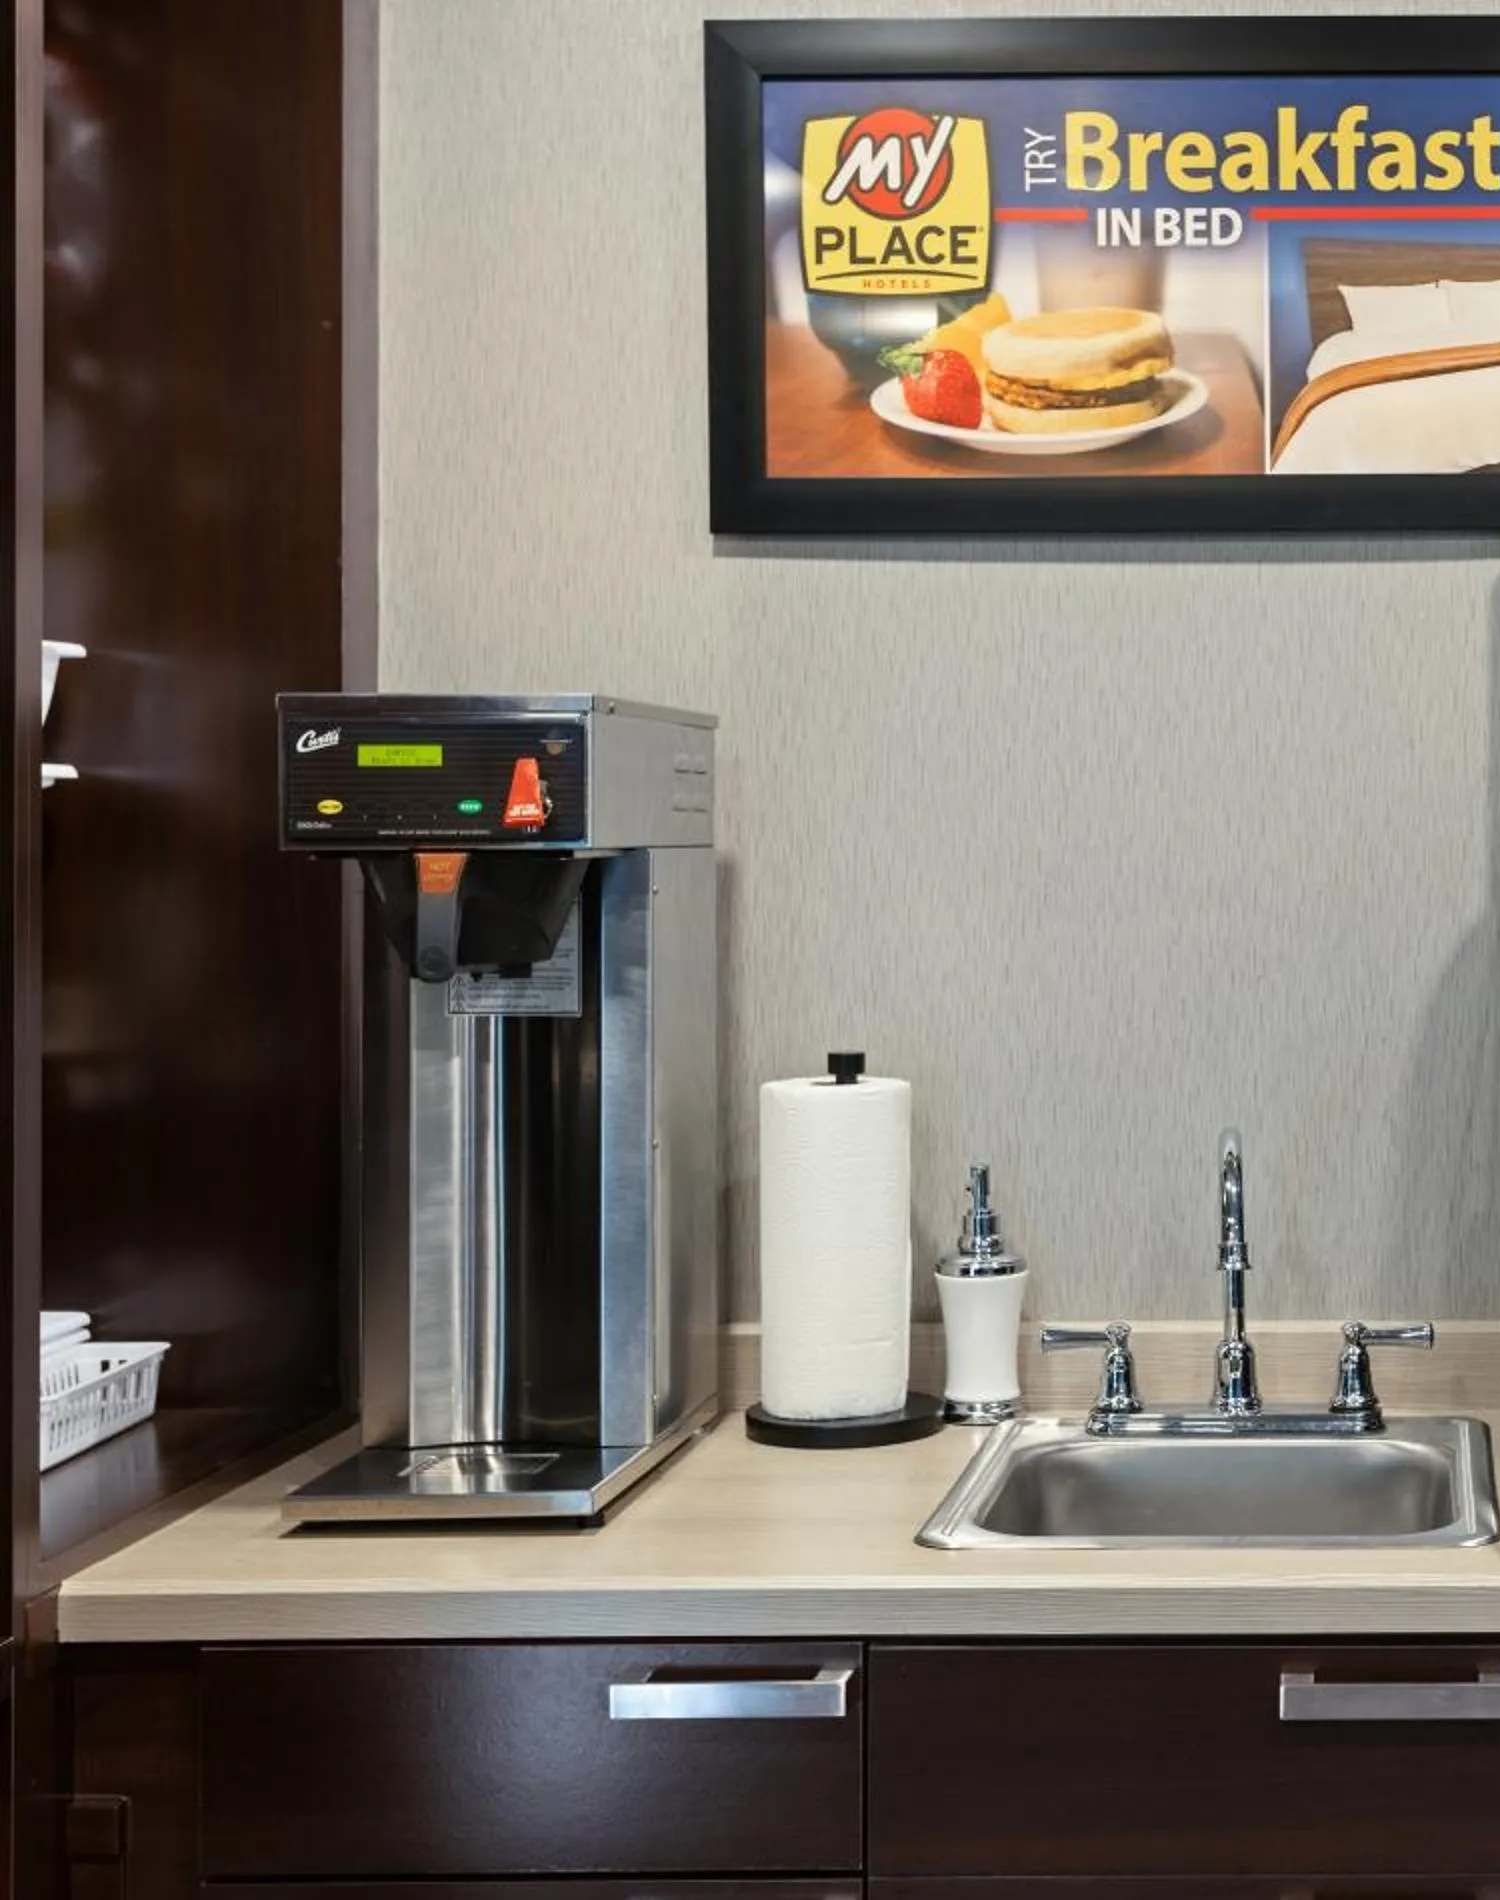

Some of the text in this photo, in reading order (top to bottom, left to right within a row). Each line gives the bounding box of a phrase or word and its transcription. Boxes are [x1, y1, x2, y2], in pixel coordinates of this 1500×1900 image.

[823, 115, 954, 209] MY
[1024, 126, 1057, 192] TRY
[814, 224, 978, 267] PLACE
[1096, 207, 1243, 247] IN BED
[862, 278, 933, 290] HOTELS
